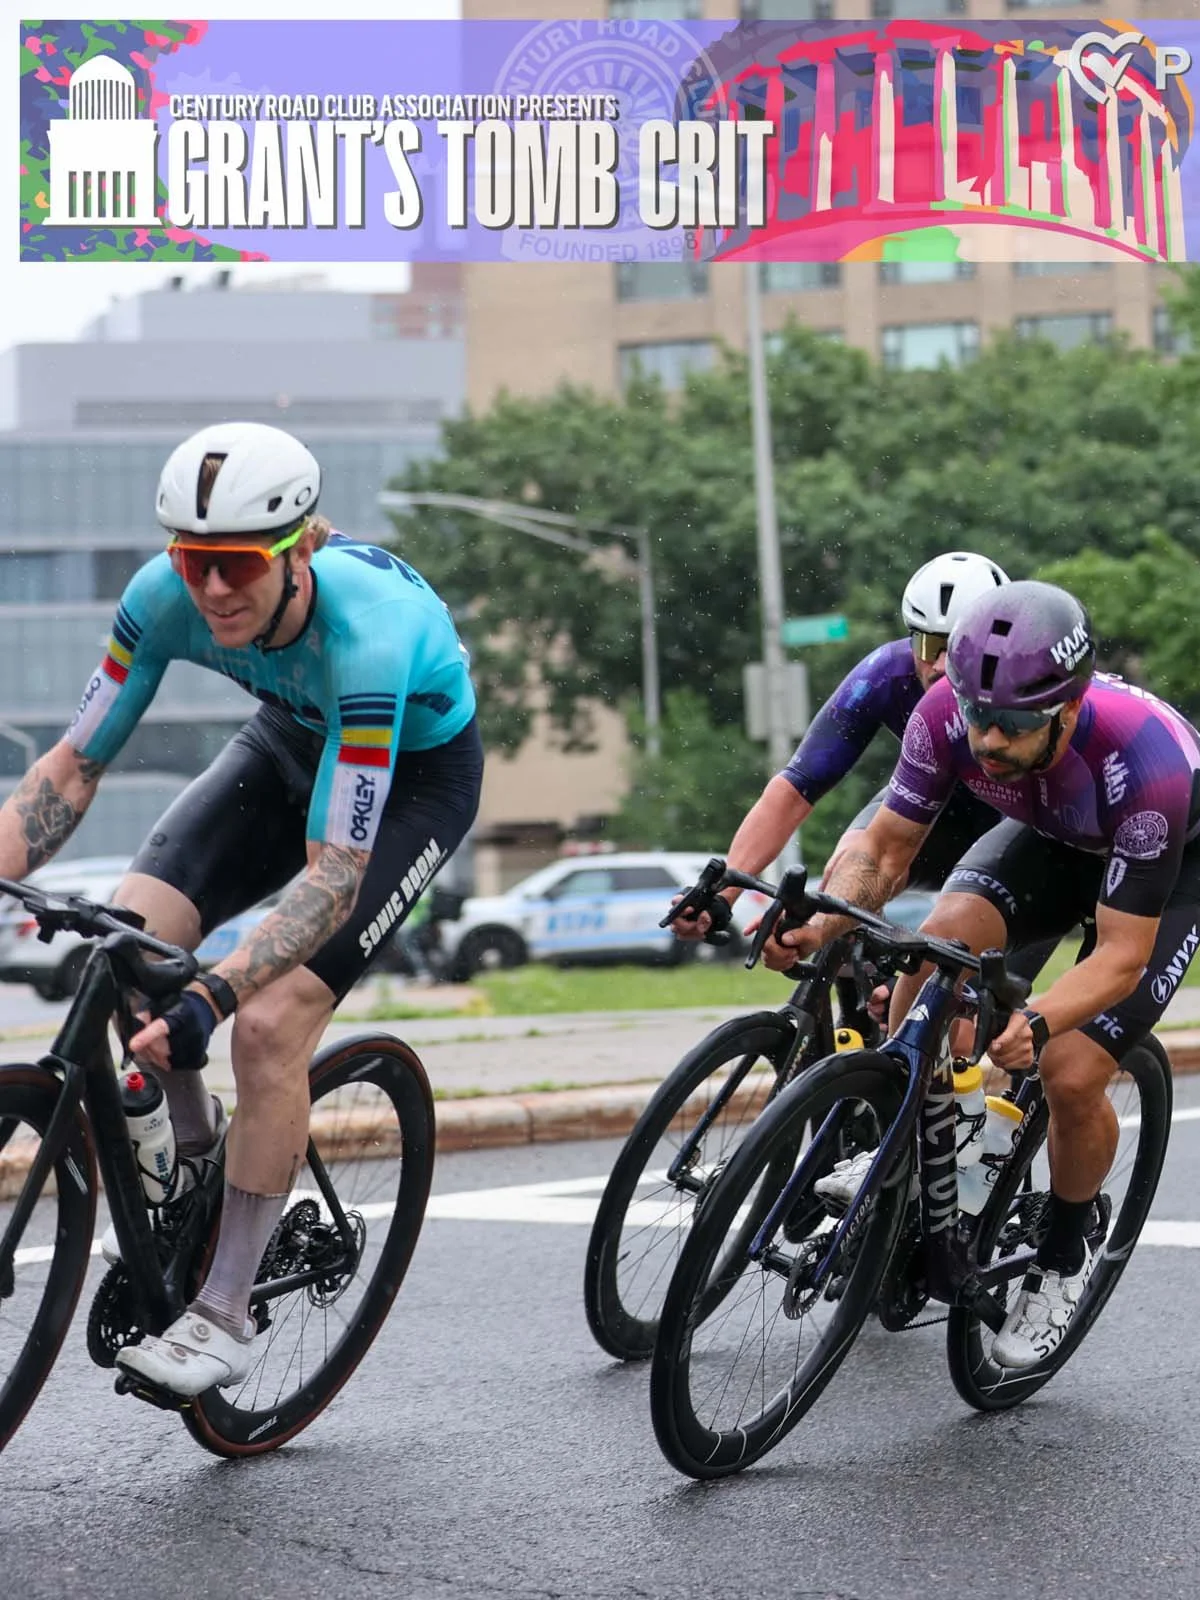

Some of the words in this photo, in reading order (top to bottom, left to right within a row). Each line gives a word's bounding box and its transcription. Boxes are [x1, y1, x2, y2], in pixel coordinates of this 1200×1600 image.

[350, 774, 376, 842] OAKLEY
[968, 778, 1024, 799] COLOMBIA
[358, 890, 405, 959] SONIC
[400, 836, 442, 904] BOOM
